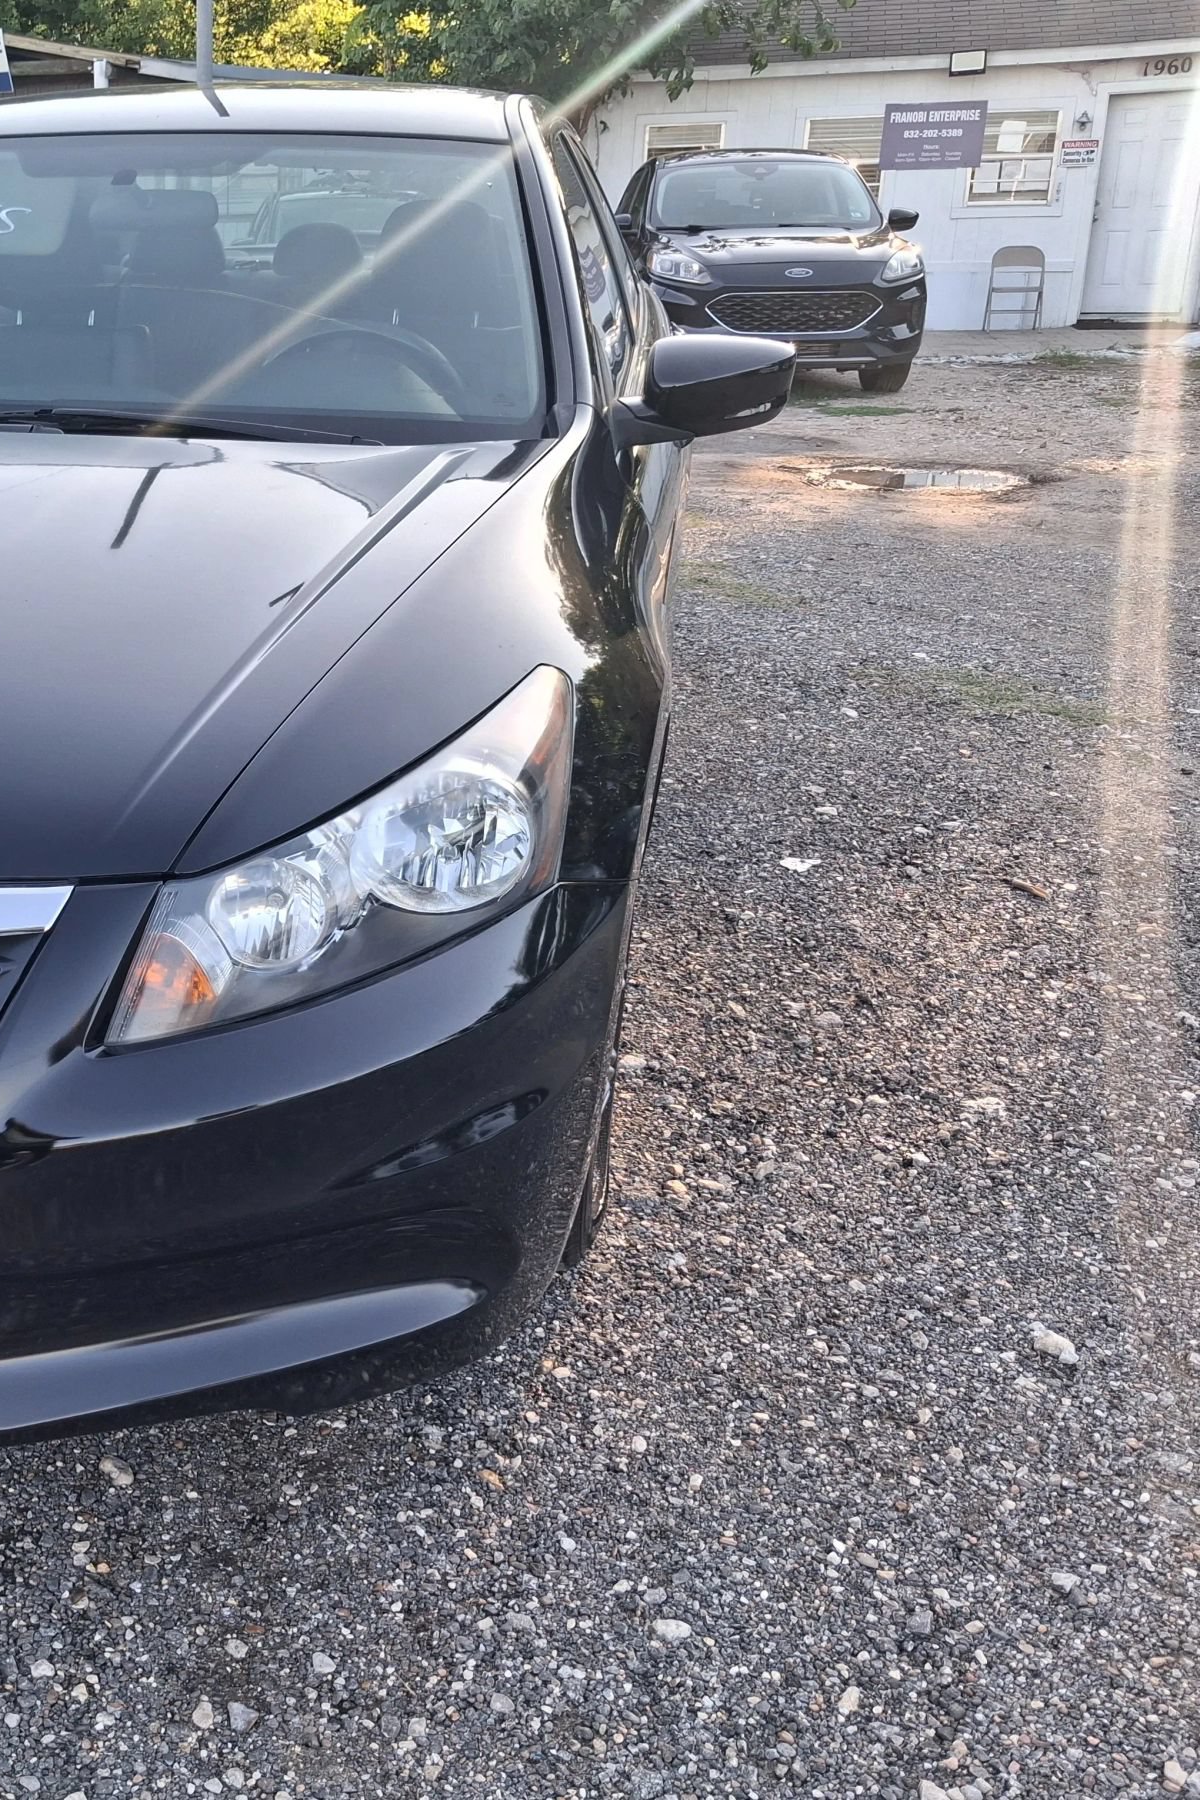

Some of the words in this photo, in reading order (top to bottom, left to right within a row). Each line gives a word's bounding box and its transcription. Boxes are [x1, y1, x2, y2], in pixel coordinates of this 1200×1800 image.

[1143, 56, 1193, 77] 1960
[890, 111, 928, 124] FRANOBI
[928, 109, 981, 122] ENTERPRISE
[903, 128, 963, 139] 832-202-5389
